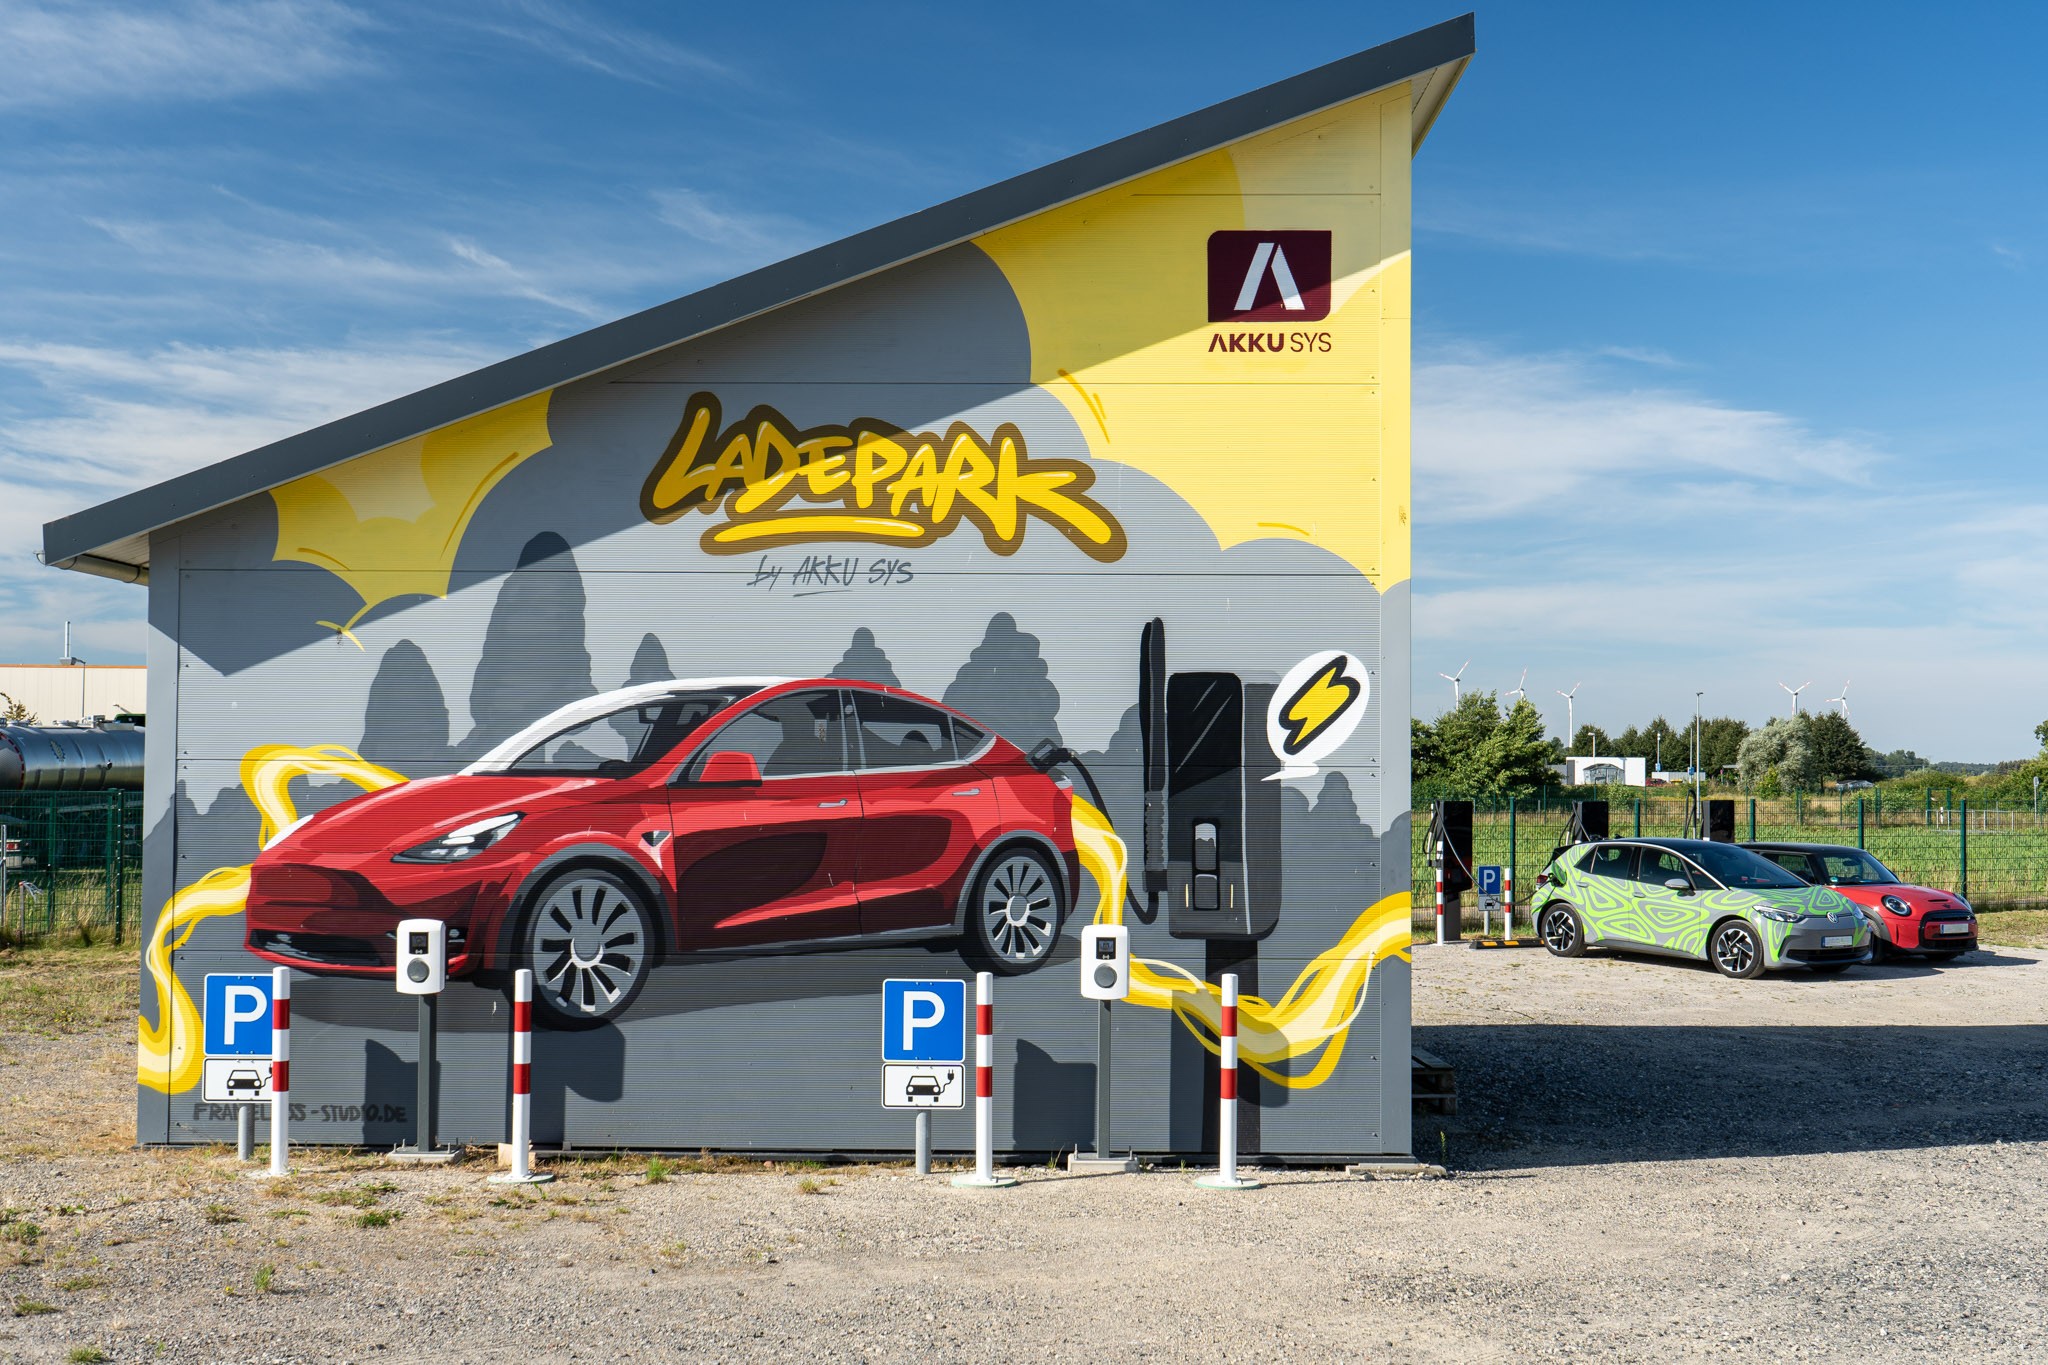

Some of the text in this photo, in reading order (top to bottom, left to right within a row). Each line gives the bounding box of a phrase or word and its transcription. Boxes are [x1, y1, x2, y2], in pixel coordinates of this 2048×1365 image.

[1208, 332, 1332, 353] AKKU SYS
[650, 404, 1115, 545] LADEPARK
[746, 554, 914, 592] by AKKU SYS
[1483, 869, 1496, 891] P
[224, 985, 268, 1045] P
[903, 990, 946, 1051] P
